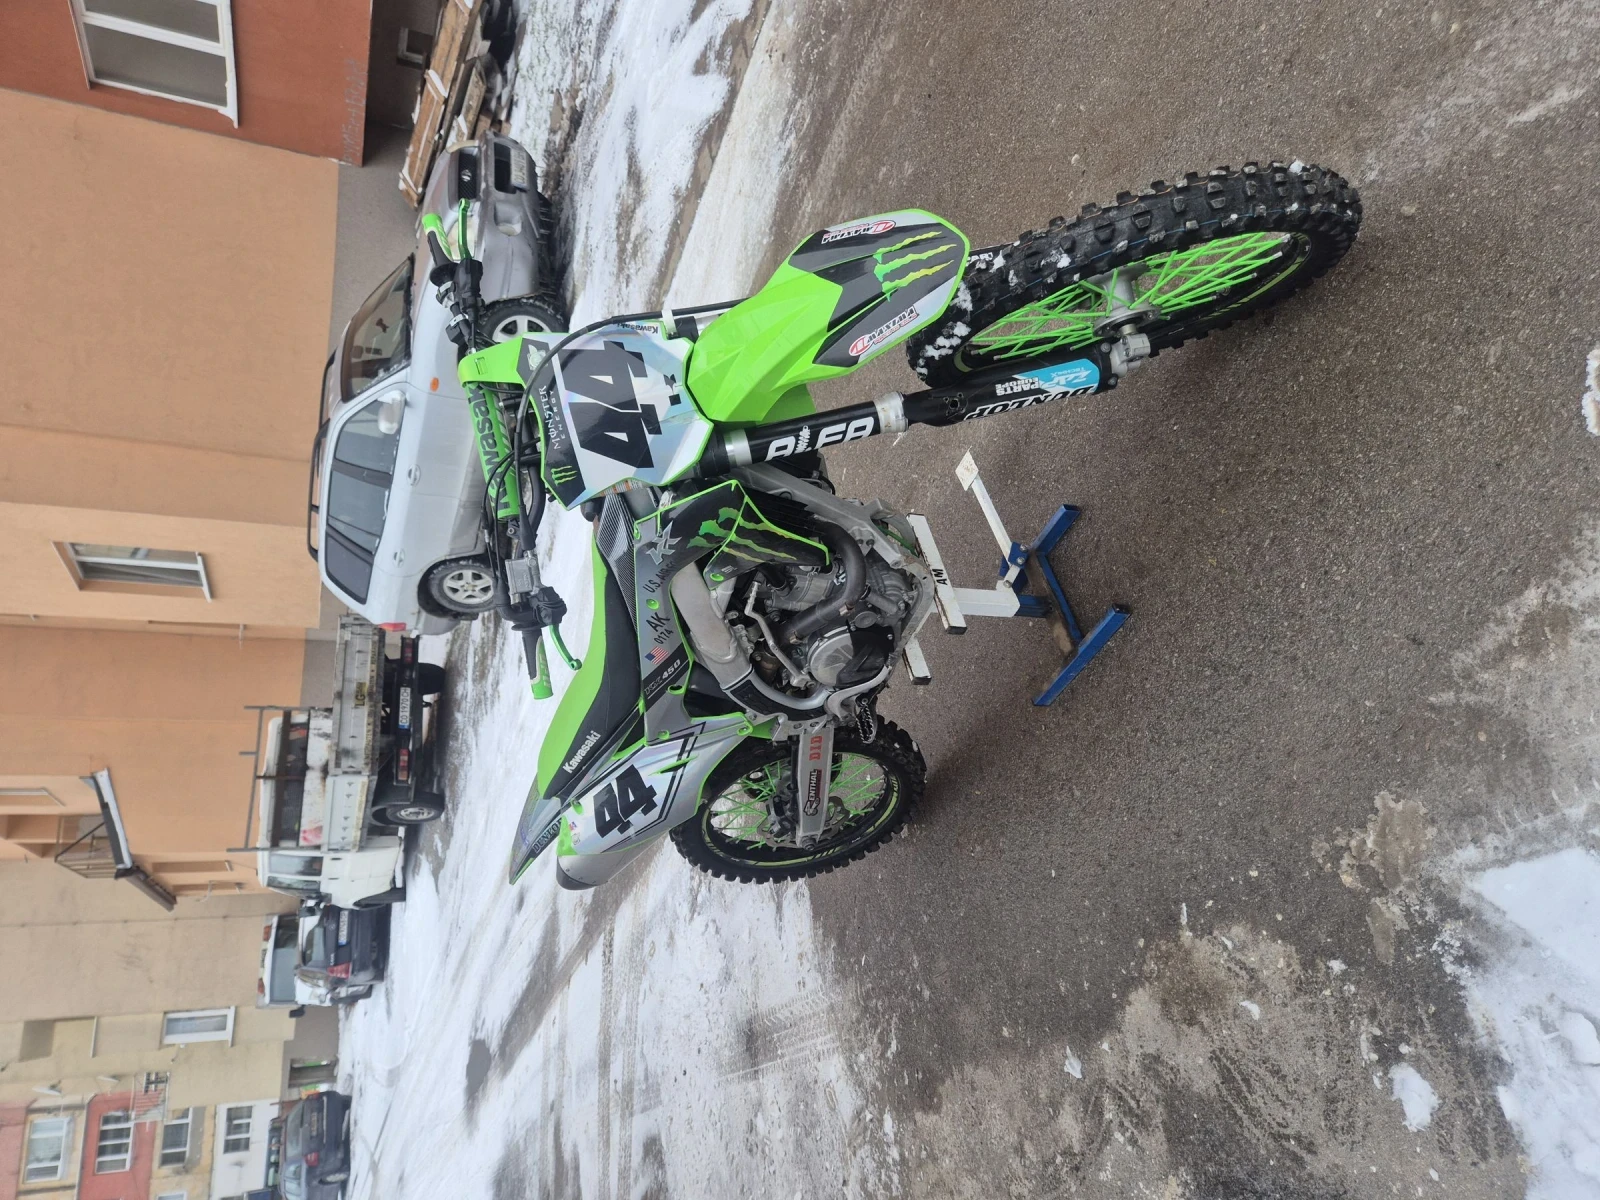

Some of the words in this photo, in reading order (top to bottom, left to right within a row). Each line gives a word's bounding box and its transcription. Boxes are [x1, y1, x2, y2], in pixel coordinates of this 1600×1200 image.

[995, 381, 1040, 396] PARTS
[557, 340, 663, 469] 44
[466, 383, 512, 511] Kawasak
[932, 568, 948, 586] AM
[646, 612, 671, 633] AK
[654, 628, 675, 645] 0174
[661, 658, 682, 681] 450
[355, 694, 366, 706] LG
[401, 688, 410, 698] CH
[400, 698, 410, 713] 1970
[400, 713, 409, 724] CO
[562, 730, 601, 774] Kawasaki
[808, 736, 822, 761] DID
[592, 764, 658, 839] 44
